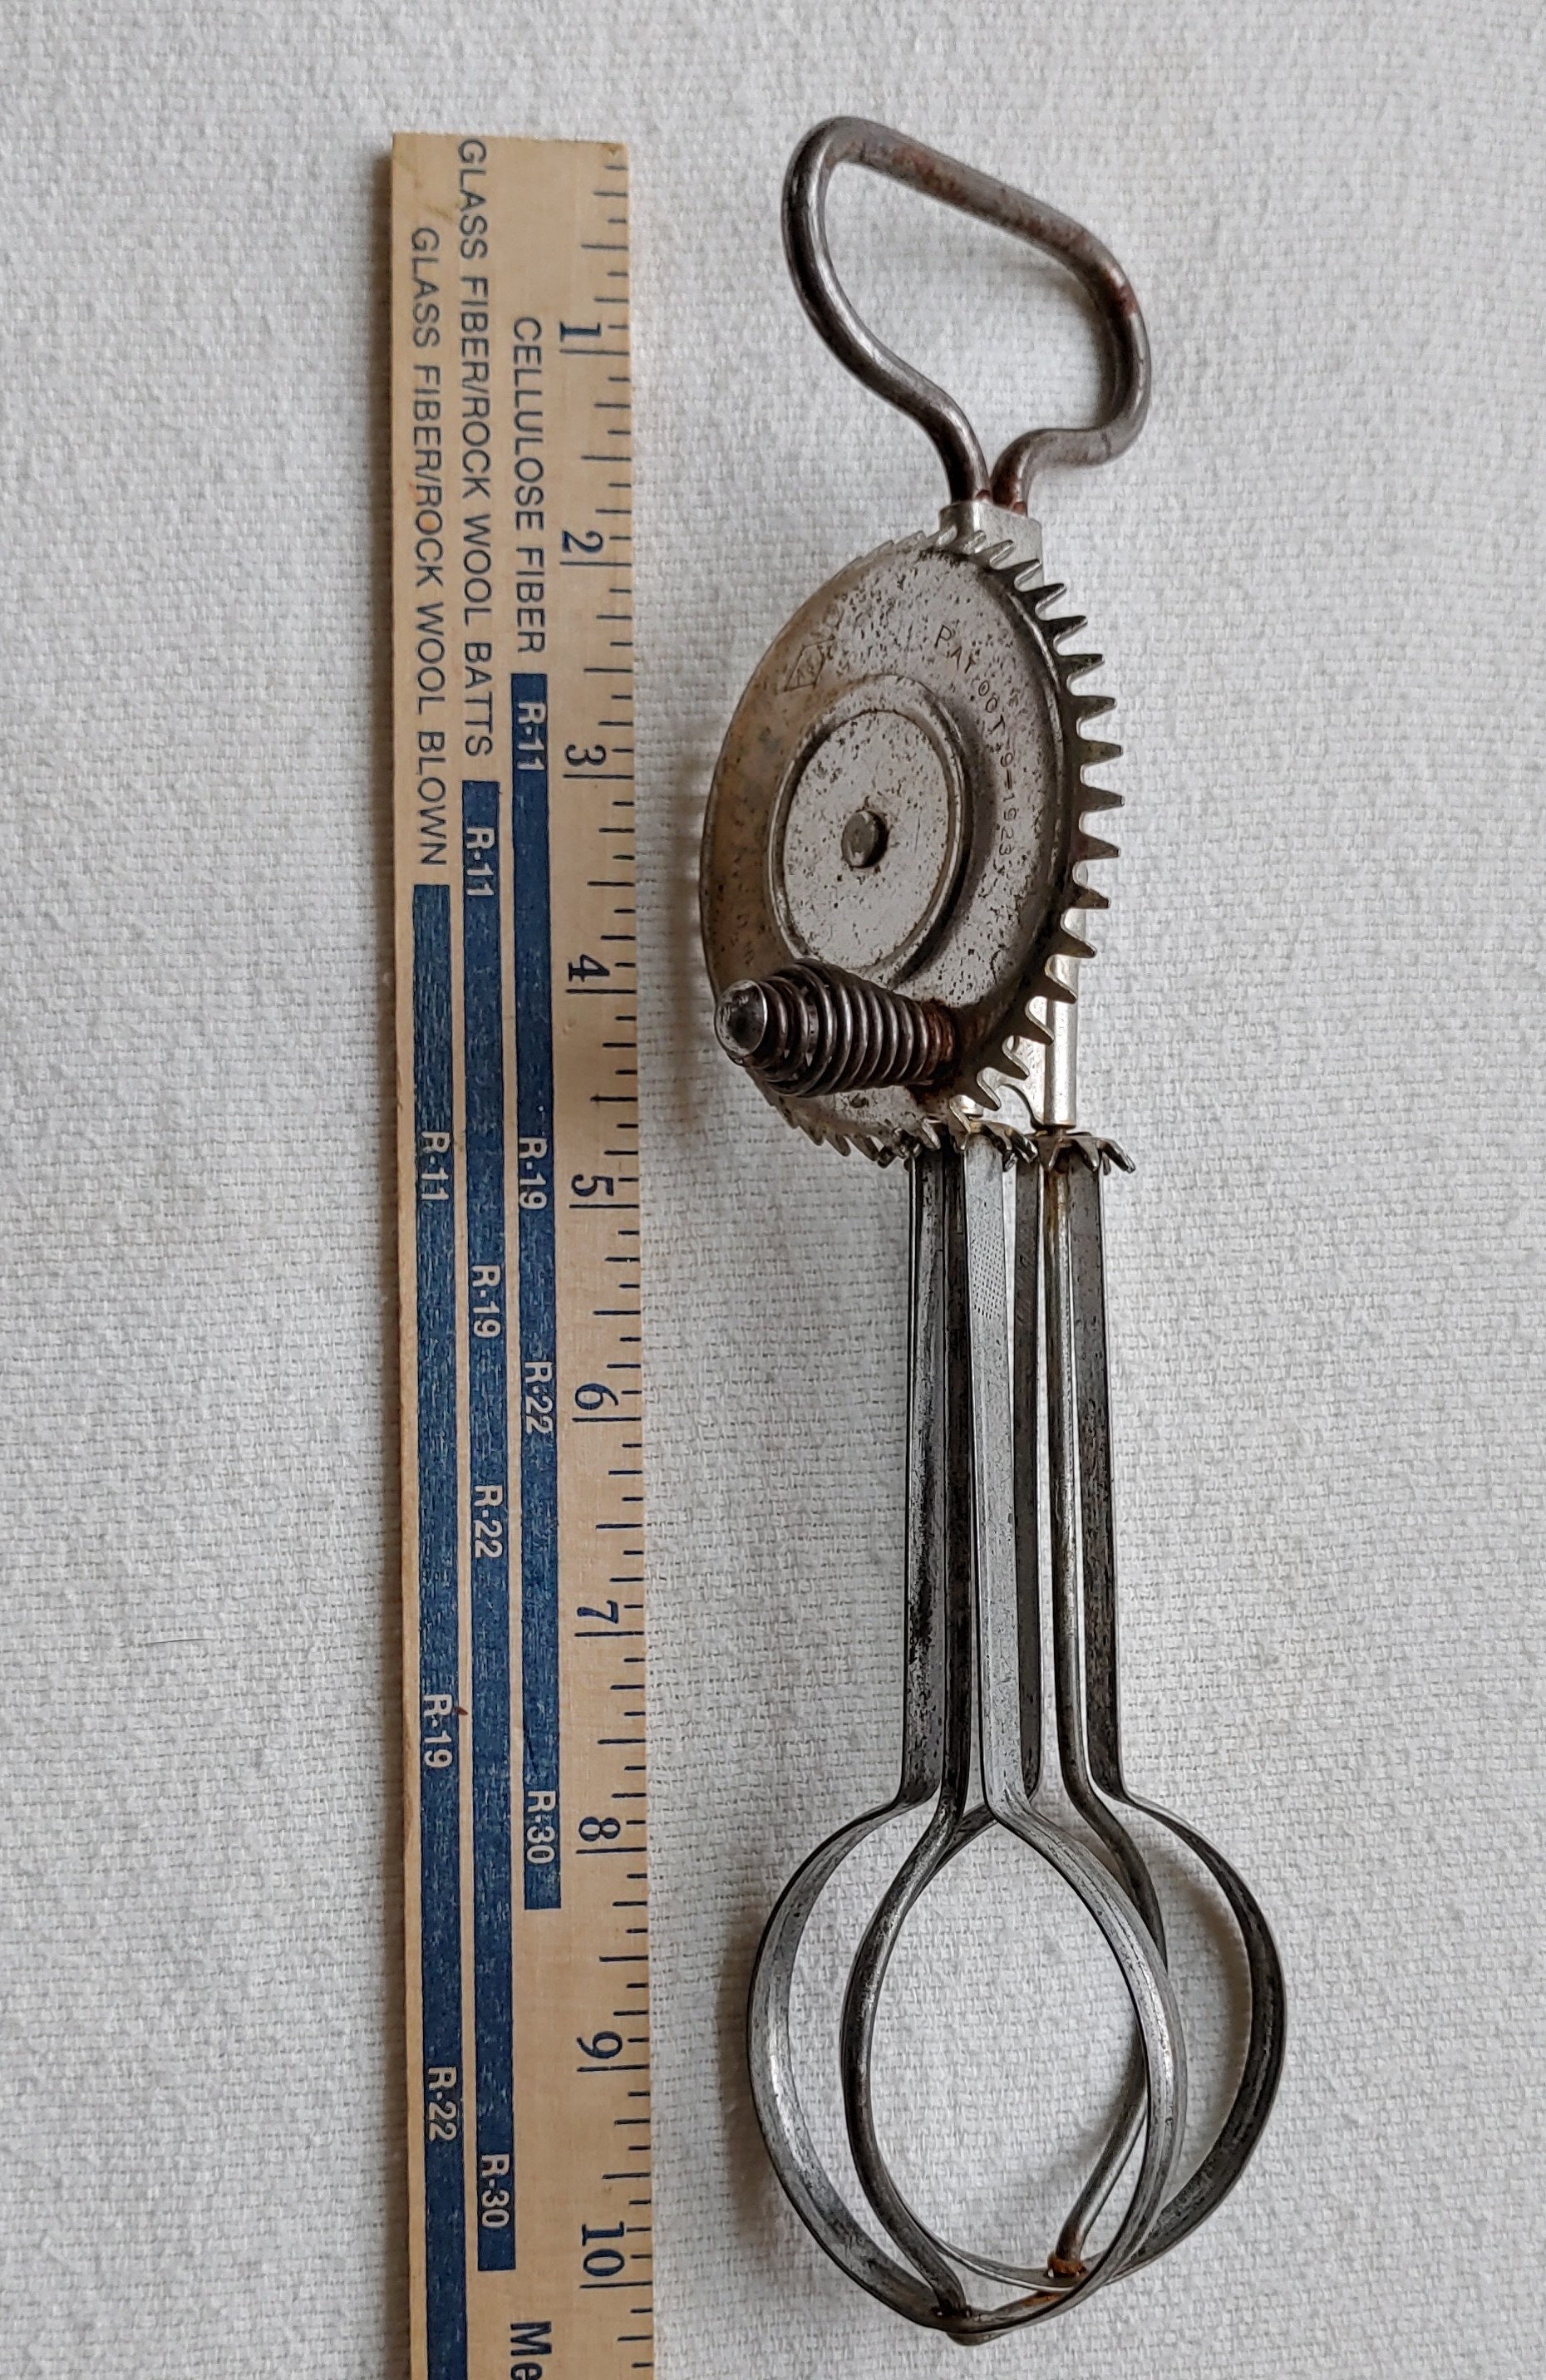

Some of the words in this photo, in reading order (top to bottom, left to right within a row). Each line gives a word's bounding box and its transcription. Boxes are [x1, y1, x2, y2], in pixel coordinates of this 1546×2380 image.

[457, 139, 488, 259] GLASS
[411, 228, 441, 347] GLASS
[559, 322, 601, 342] 1
[460, 277, 491, 498] FIBER/ROCK
[513, 317, 544, 530] CELLULOSE
[413, 365, 443, 588] FIBER/ROCK
[463, 514, 492, 626] WOOL
[562, 530, 603, 553] 2
[515, 547, 545, 653] FIBER
[416, 602, 446, 715] WOOL
[464, 642, 493, 756] BATTS
[515, 701, 547, 771] R-11
[565, 744, 607, 766] 3
[417, 731, 447, 865] BLOWN
[465, 827, 495, 897] R-11
[568, 954, 611, 983] 4
[420, 1131, 451, 1202] R-11
[519, 1136, 549, 1210] R-19
[571, 1173, 614, 1197] 5
[471, 1264, 502, 1339] R-19
[524, 1360, 554, 1434] R-22
[574, 1383, 619, 1411] 6
[475, 1484, 503, 1559] R-22
[576, 1600, 619, 1625] 7
[422, 1694, 454, 1769] R-19
[526, 1790, 557, 1865] R-30
[578, 1816, 621, 1842] 8
[576, 2031, 623, 2059] 9
[427, 2065, 458, 2142] R-22
[480, 2153, 510, 2230] R-30
[581, 2220, 625, 2277] 10
